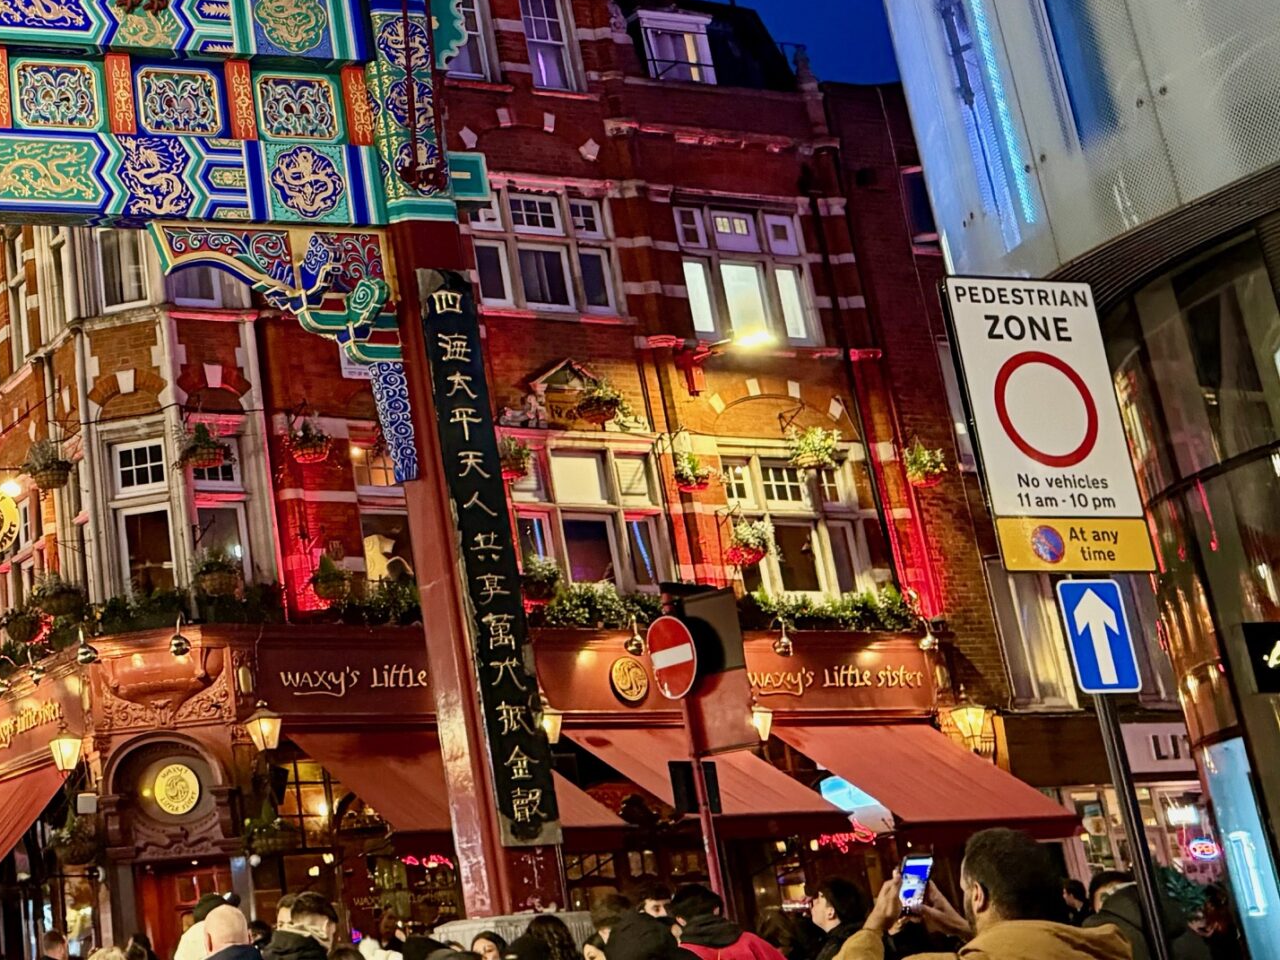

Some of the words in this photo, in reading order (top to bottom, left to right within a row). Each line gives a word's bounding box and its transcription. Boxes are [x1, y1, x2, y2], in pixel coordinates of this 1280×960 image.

[955, 286, 1089, 307] PEDESTRIAN
[984, 315, 1072, 342] ZONE
[1017, 473, 1039, 489] No
[1047, 474, 1109, 490] vehicles
[1070, 494, 1089, 509] 10
[1093, 497, 1116, 511] pm
[1069, 527, 1087, 542] At
[1092, 529, 1119, 545] any
[1080, 546, 1116, 562] time
